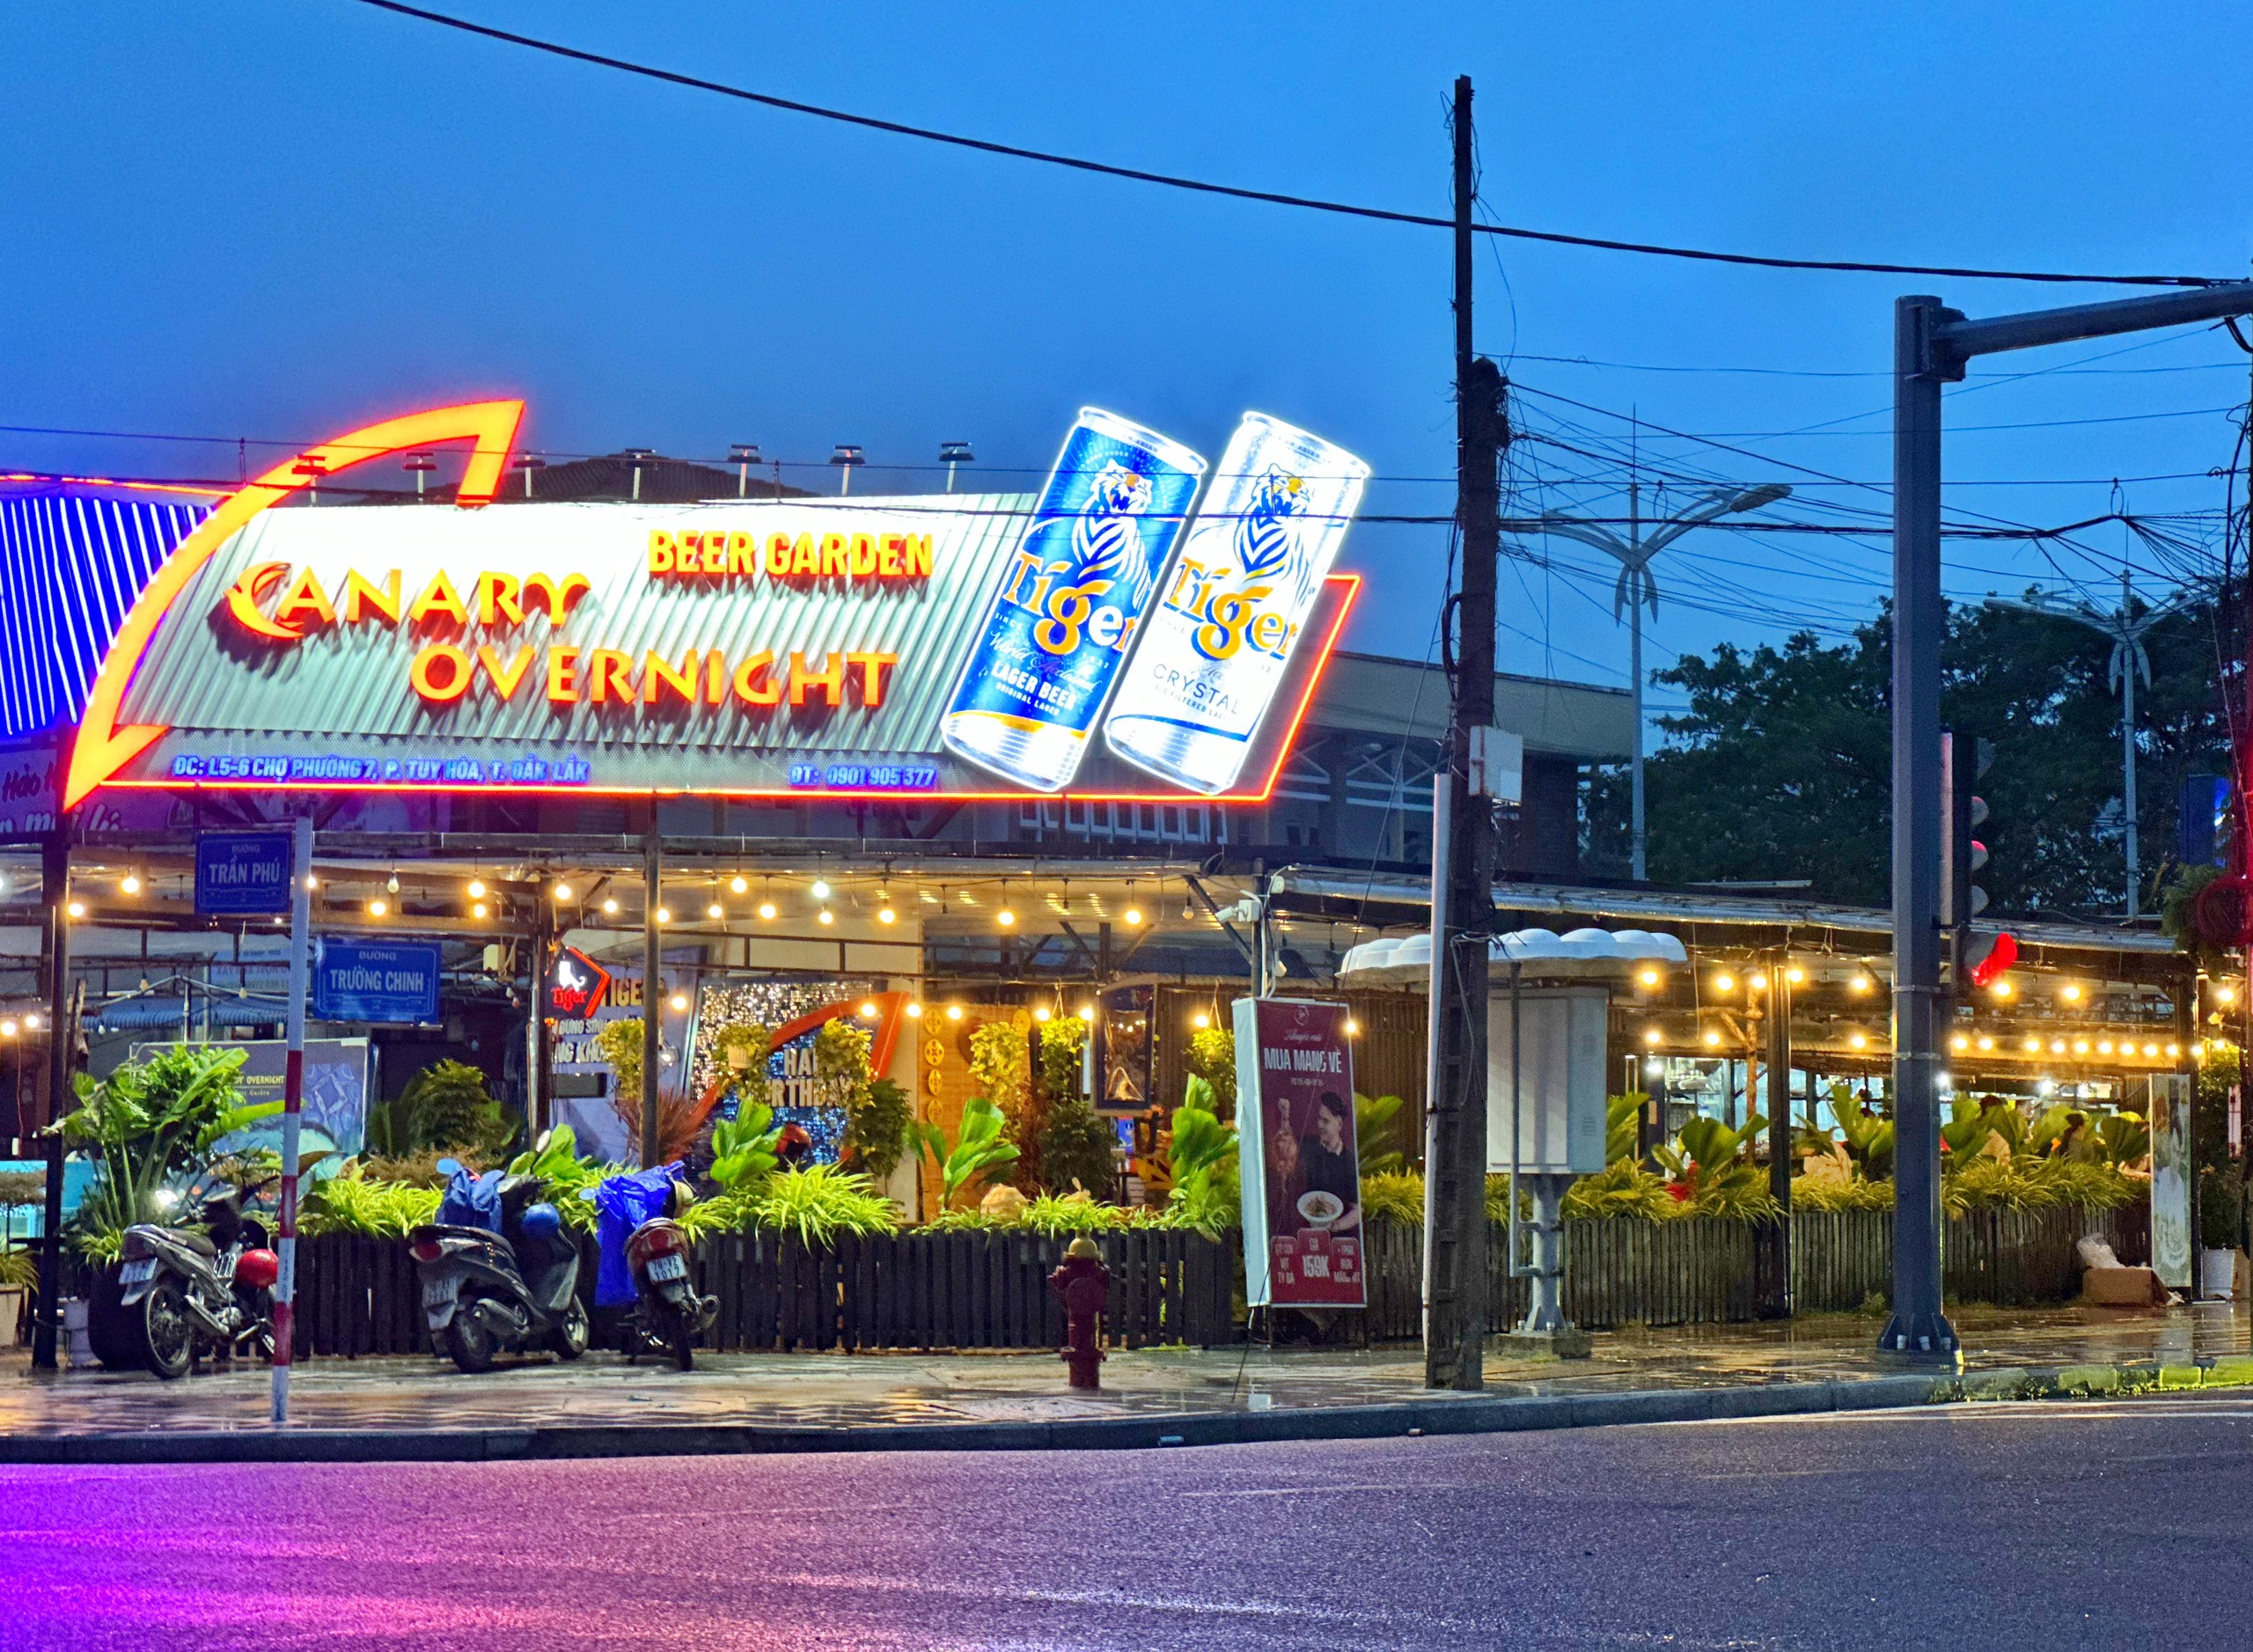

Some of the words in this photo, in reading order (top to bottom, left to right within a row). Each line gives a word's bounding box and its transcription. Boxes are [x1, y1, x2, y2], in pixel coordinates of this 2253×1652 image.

[648, 530, 756, 575] BEER
[765, 531, 934, 577] GARDEN
[224, 561, 591, 638] CANARY
[1002, 548, 1137, 655] Tiger
[1163, 555, 1298, 660] Tiger
[410, 643, 899, 706] OVERNIGHT
[991, 660, 1038, 694] LAGER
[1038, 679, 1077, 711] BEER
[1153, 664, 1238, 715] CRYSTAL
[995, 681, 1031, 705] ORIGINAL
[1033, 700, 1060, 716] LAGER
[208, 757, 250, 777] L5-6
[363, 759, 378, 781] 7,
[384, 760, 402, 780] P.
[407, 760, 441, 780] TUY
[492, 760, 506, 780] T.
[826, 767, 866, 785] 0901
[869, 767, 902, 786] 905
[903, 767, 936, 787] 377
[209, 855, 247, 884] TRẦN
[252, 857, 281, 884] PHÚ
[330, 966, 382, 991] TRƯỜNG
[385, 971, 424, 992] CHINH
[551, 987, 588, 1011] Tiger
[1264, 1047, 1291, 1070] MUA
[1294, 1049, 1327, 1073] MANG
[246, 1076, 285, 1085] OVERNIGHT
[1302, 1255, 1330, 1277] 159K
